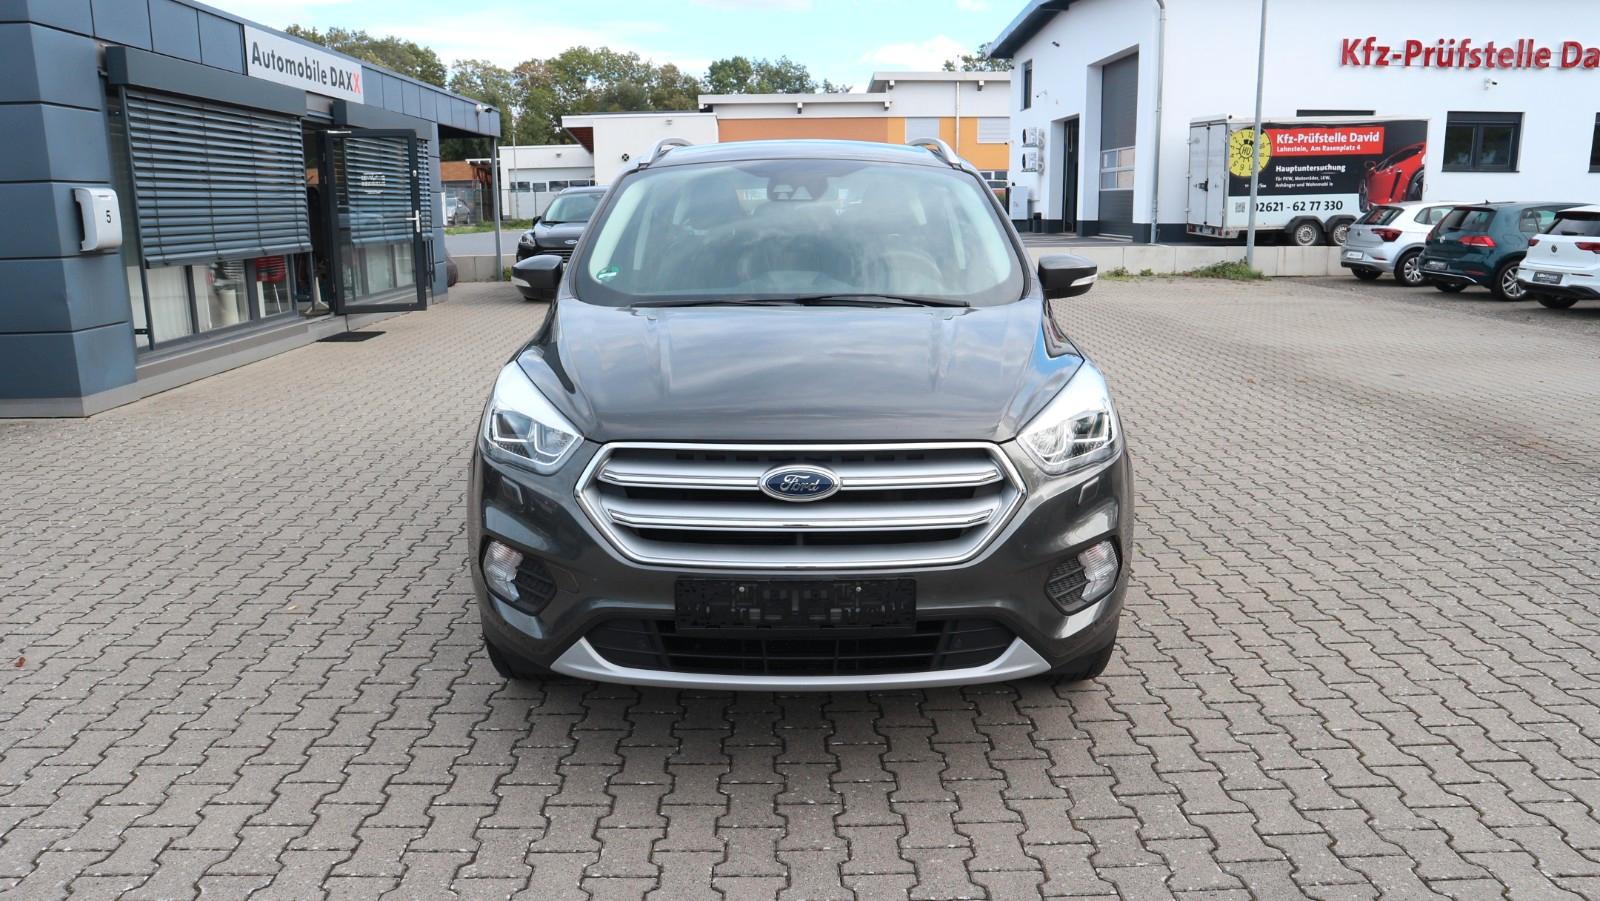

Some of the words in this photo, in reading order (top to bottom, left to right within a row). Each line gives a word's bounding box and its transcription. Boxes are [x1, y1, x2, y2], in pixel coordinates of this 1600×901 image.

[1341, 36, 1551, 68] Kfz-Prüfstelle
[252, 41, 327, 85] Automobile
[330, 66, 361, 93] DAXX
[1276, 132, 1347, 144] Kfz-Prüfstelle
[1349, 131, 1380, 143] David
[1275, 163, 1346, 174] Hauptuntersuchung
[1292, 201, 1306, 212] 62
[1309, 200, 1321, 211] 77
[1325, 200, 1343, 211] 330
[105, 209, 112, 224] 5
[780, 474, 820, 492] Ford
